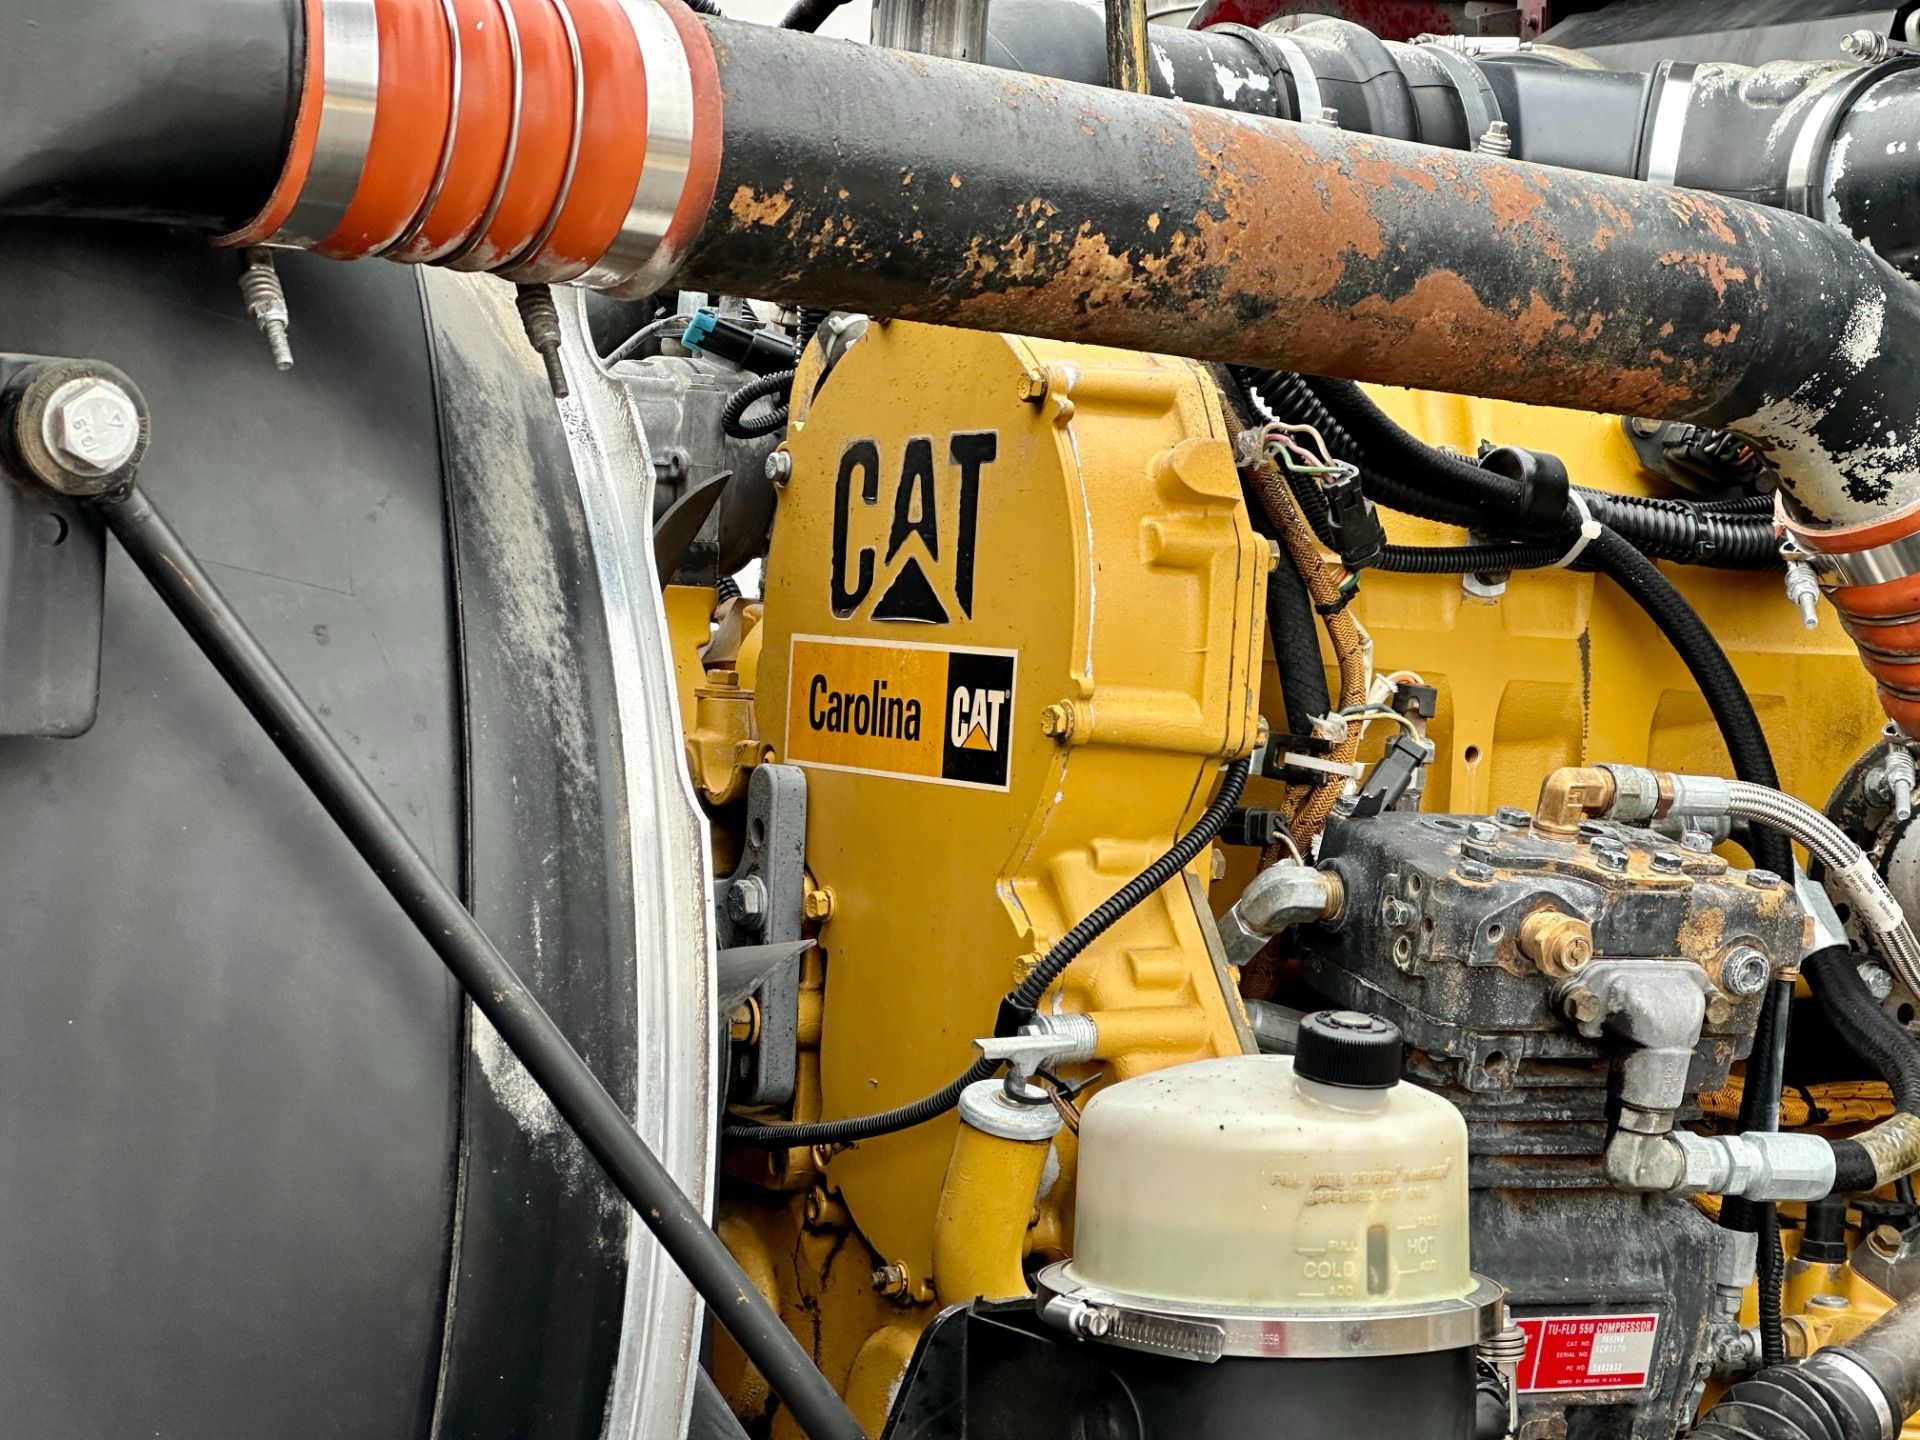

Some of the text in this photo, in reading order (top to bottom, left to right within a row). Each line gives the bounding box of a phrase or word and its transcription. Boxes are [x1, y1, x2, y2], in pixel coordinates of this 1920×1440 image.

[831, 431, 997, 622] CAT
[808, 673, 921, 742] Carolina
[1270, 1172, 1303, 1185] FILL
[1311, 1172, 1344, 1187] WITH
[1305, 1189, 1374, 1205] APPROVED
[1327, 1240, 1358, 1252] FULL
[1407, 1236, 1437, 1255] HOT
[1303, 1261, 1356, 1279] COLD
[1327, 1284, 1354, 1296] ADD
[1548, 1321, 1652, 1335] TU-FLO 550 COMPRESSOR
